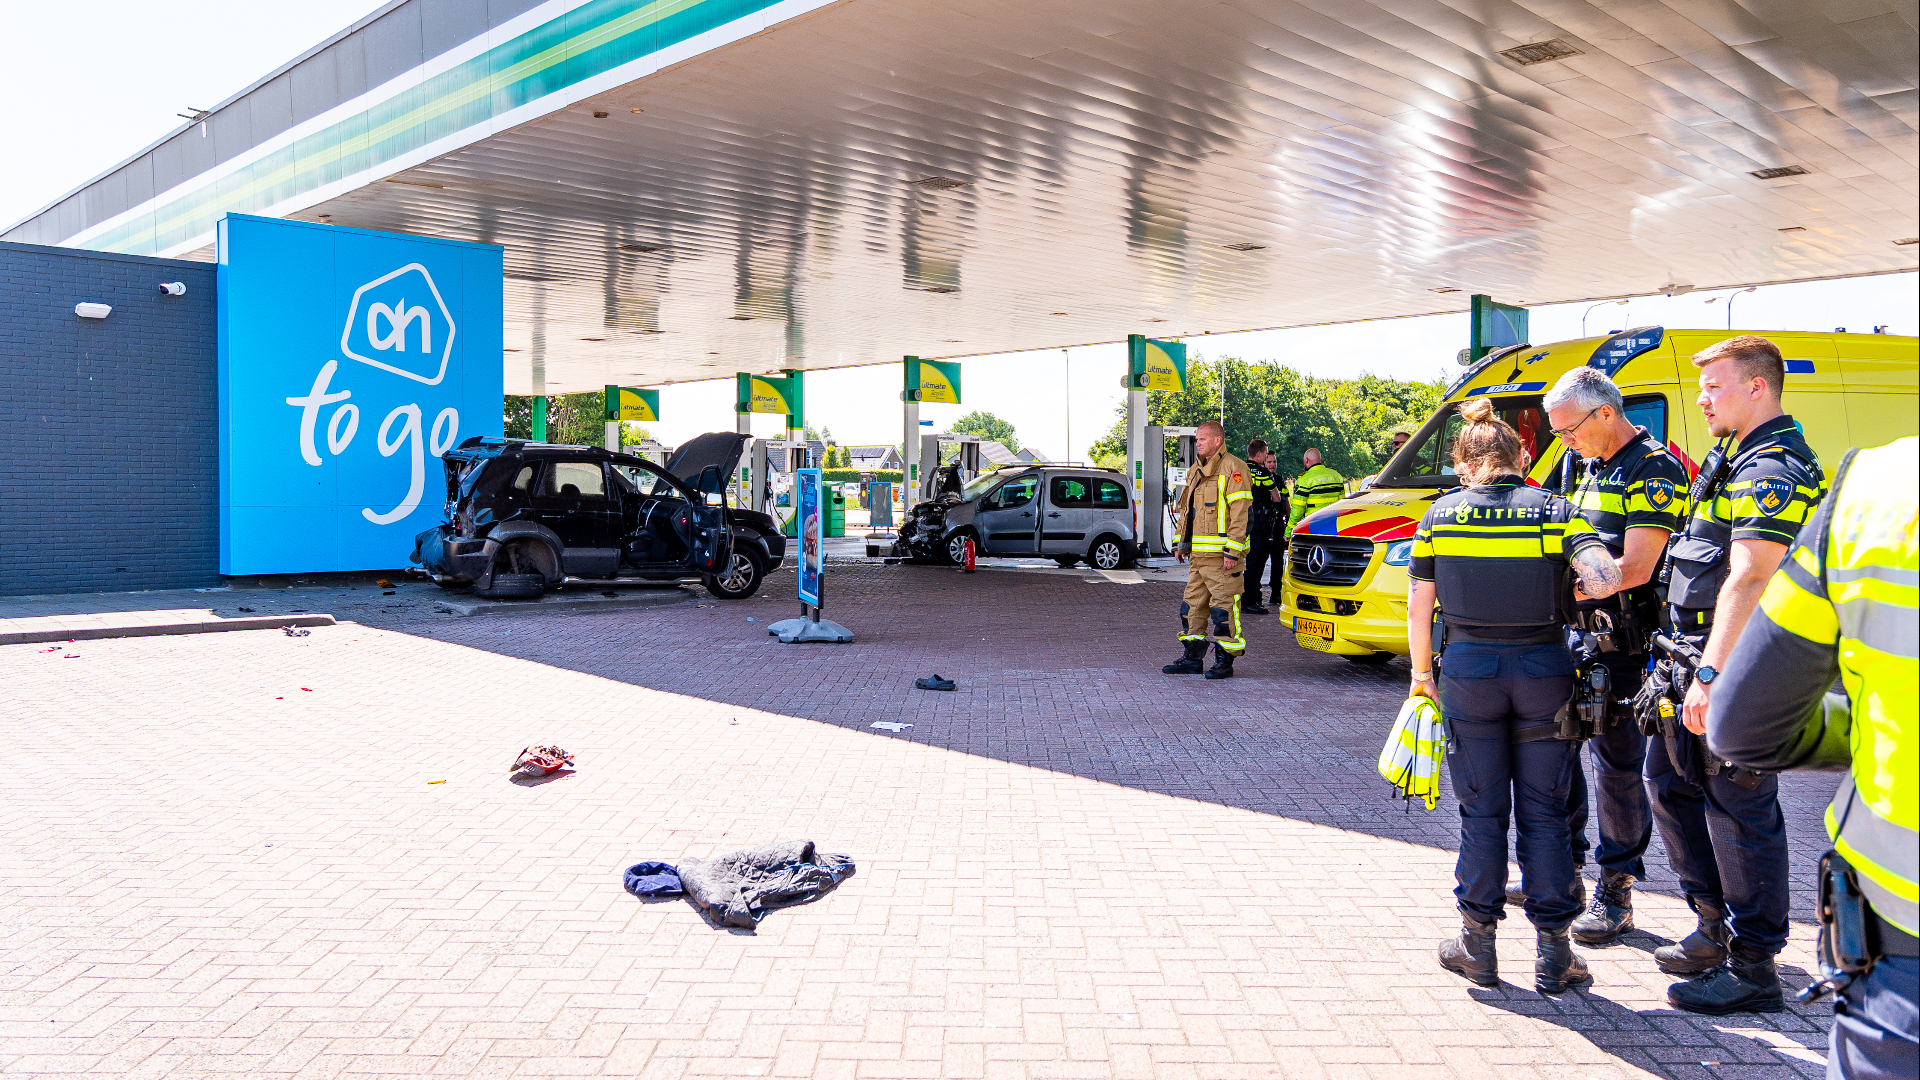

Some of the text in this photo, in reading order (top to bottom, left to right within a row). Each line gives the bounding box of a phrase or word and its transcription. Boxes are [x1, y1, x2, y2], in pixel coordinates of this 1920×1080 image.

[1147, 366, 1172, 375] ultimate
[285, 359, 460, 526] to go
[1648, 481, 1673, 490] POLITIE
[1756, 481, 1789, 491] POLITIE
[1445, 504, 1527, 524] POLITIE
[1297, 619, 1330, 636] N-496-VK
